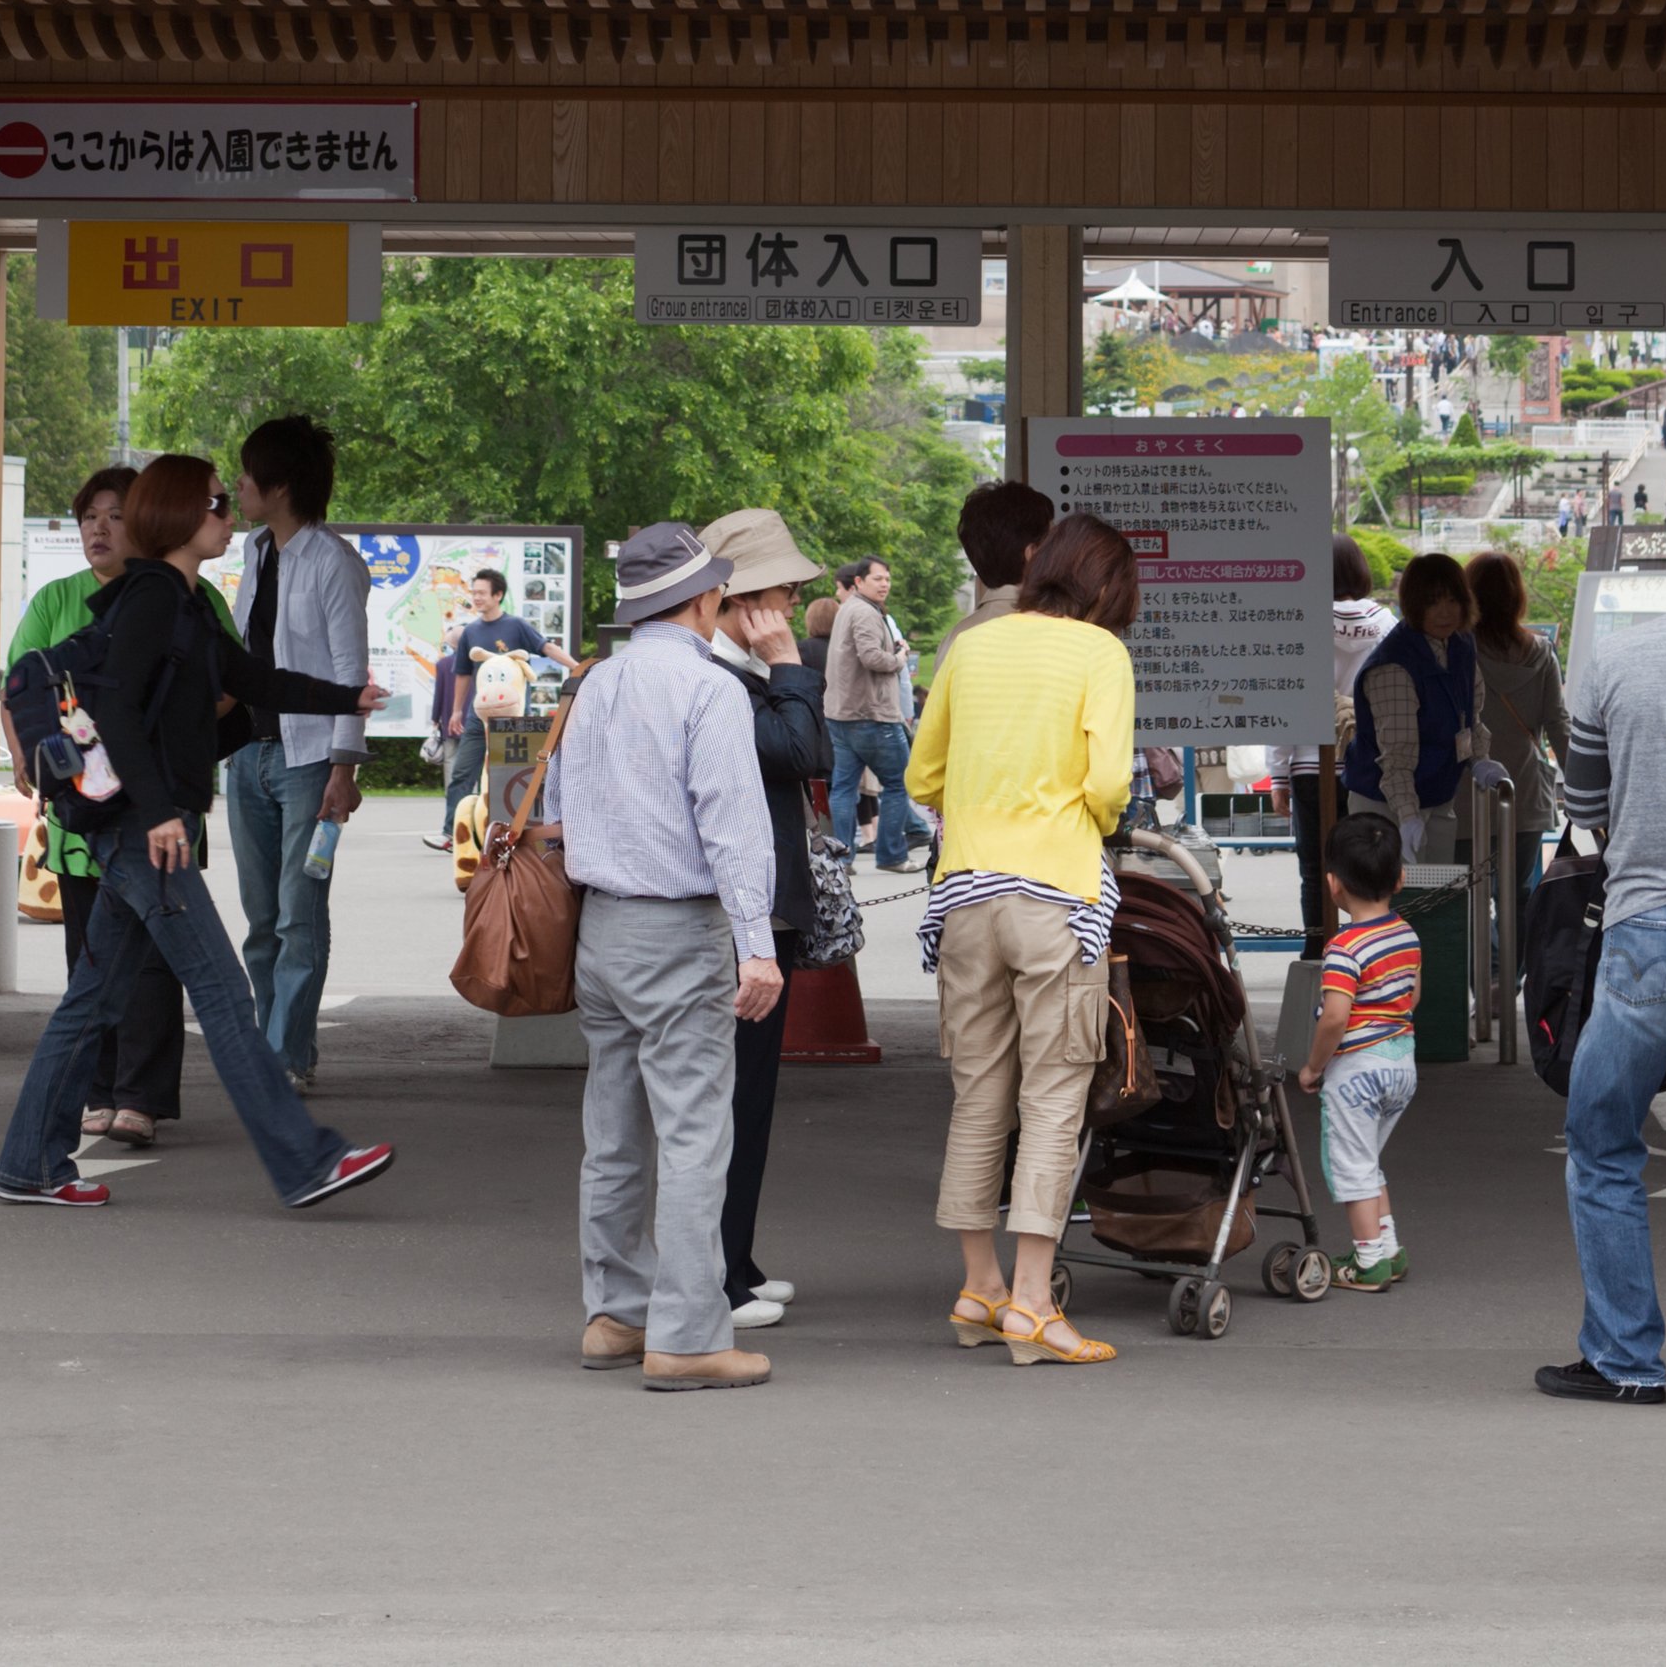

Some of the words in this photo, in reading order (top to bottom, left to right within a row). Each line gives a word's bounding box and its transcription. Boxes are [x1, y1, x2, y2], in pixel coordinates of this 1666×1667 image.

[50, 129, 398, 173] ここからは入園できません
[122, 236, 294, 290] 出口
[677, 233, 938, 288] 団体入口
[1431, 238, 1576, 292] 入口
[171, 298, 244, 322] EXIT
[651, 298, 686, 318] Group
[690, 298, 747, 318] entrance
[1351, 302, 1437, 323] Entrance
[1477, 304, 1530, 323] 入口
[1585, 304, 1639, 324] 입구
[1135, 439, 1225, 453] おやくそく
